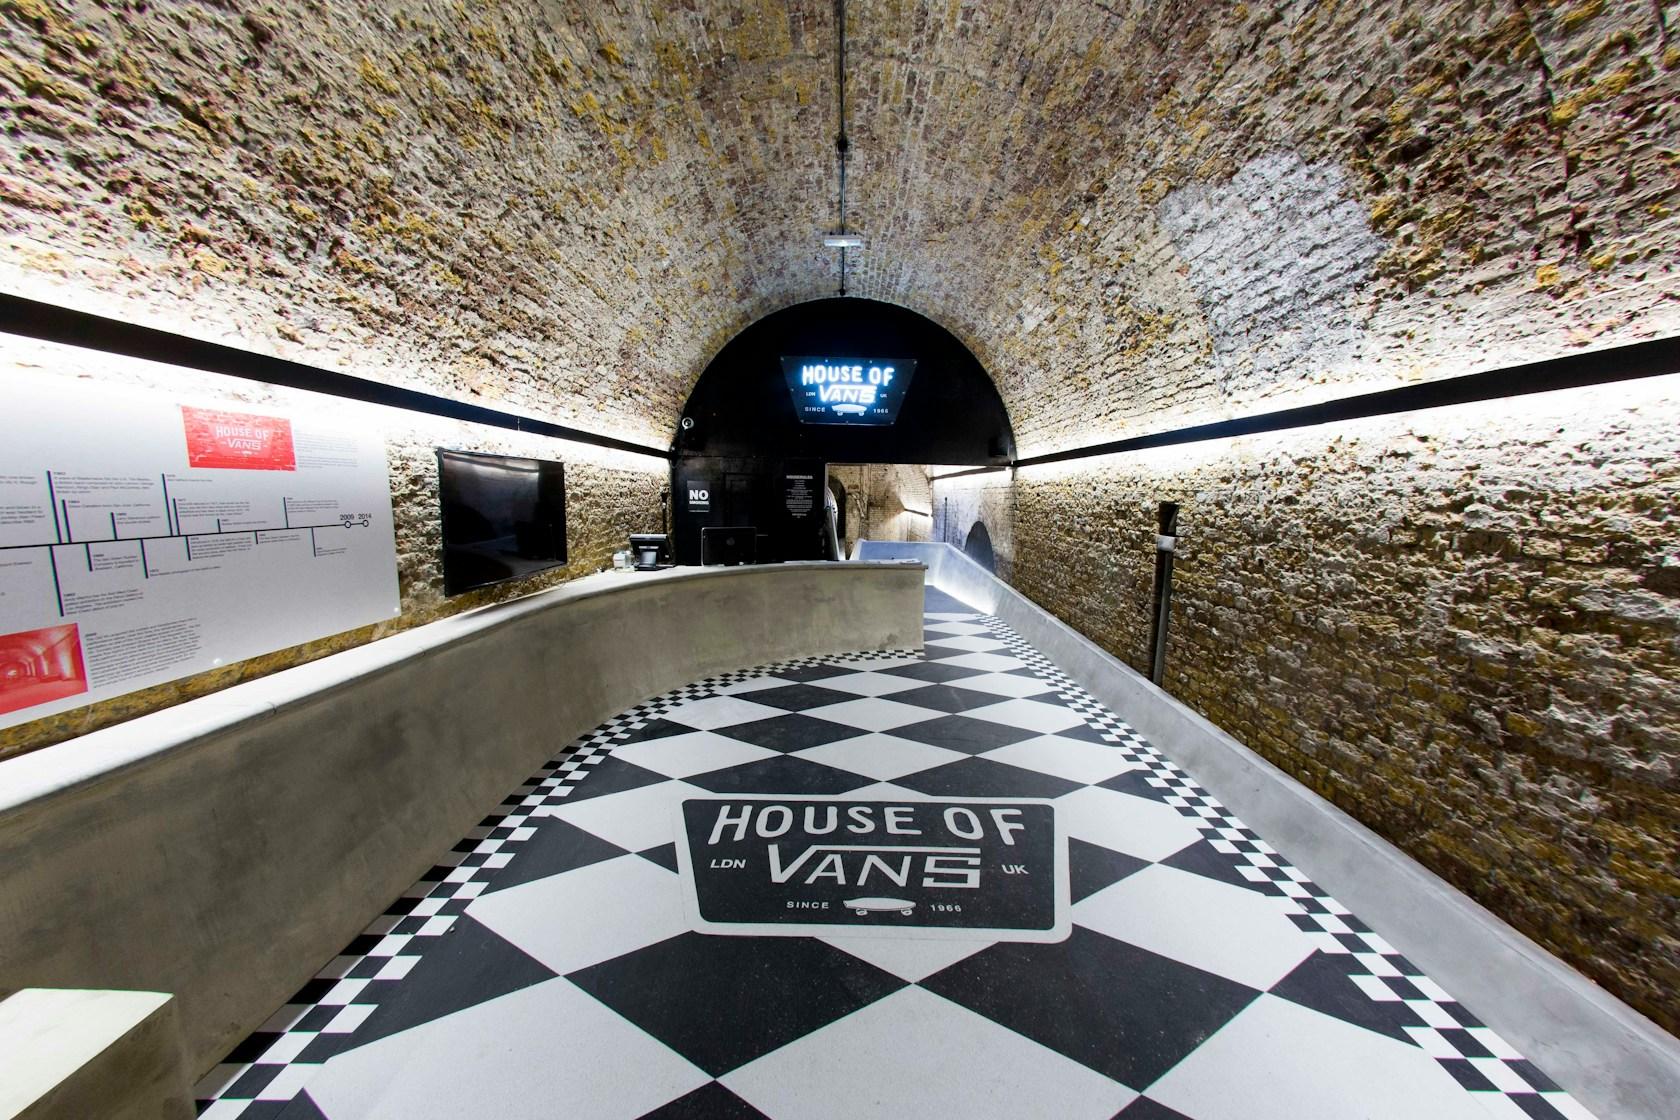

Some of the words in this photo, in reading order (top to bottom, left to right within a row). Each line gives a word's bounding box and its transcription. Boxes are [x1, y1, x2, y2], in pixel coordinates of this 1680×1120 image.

[802, 365, 863, 386] HOUSE
[869, 367, 895, 386] OF
[819, 384, 877, 404] VANS
[215, 424, 252, 438] HOUSE
[255, 428, 270, 440] OF
[227, 438, 263, 450] VANS
[689, 489, 709, 501] NO
[357, 512, 372, 520] 2014
[707, 804, 923, 846] HOUSE
[942, 807, 1026, 846] OF
[710, 858, 747, 870] LDN
[767, 844, 982, 889] VANS
[1001, 863, 1029, 875] UK
[786, 900, 830, 910] SINCE
[929, 903, 963, 913] 1966
